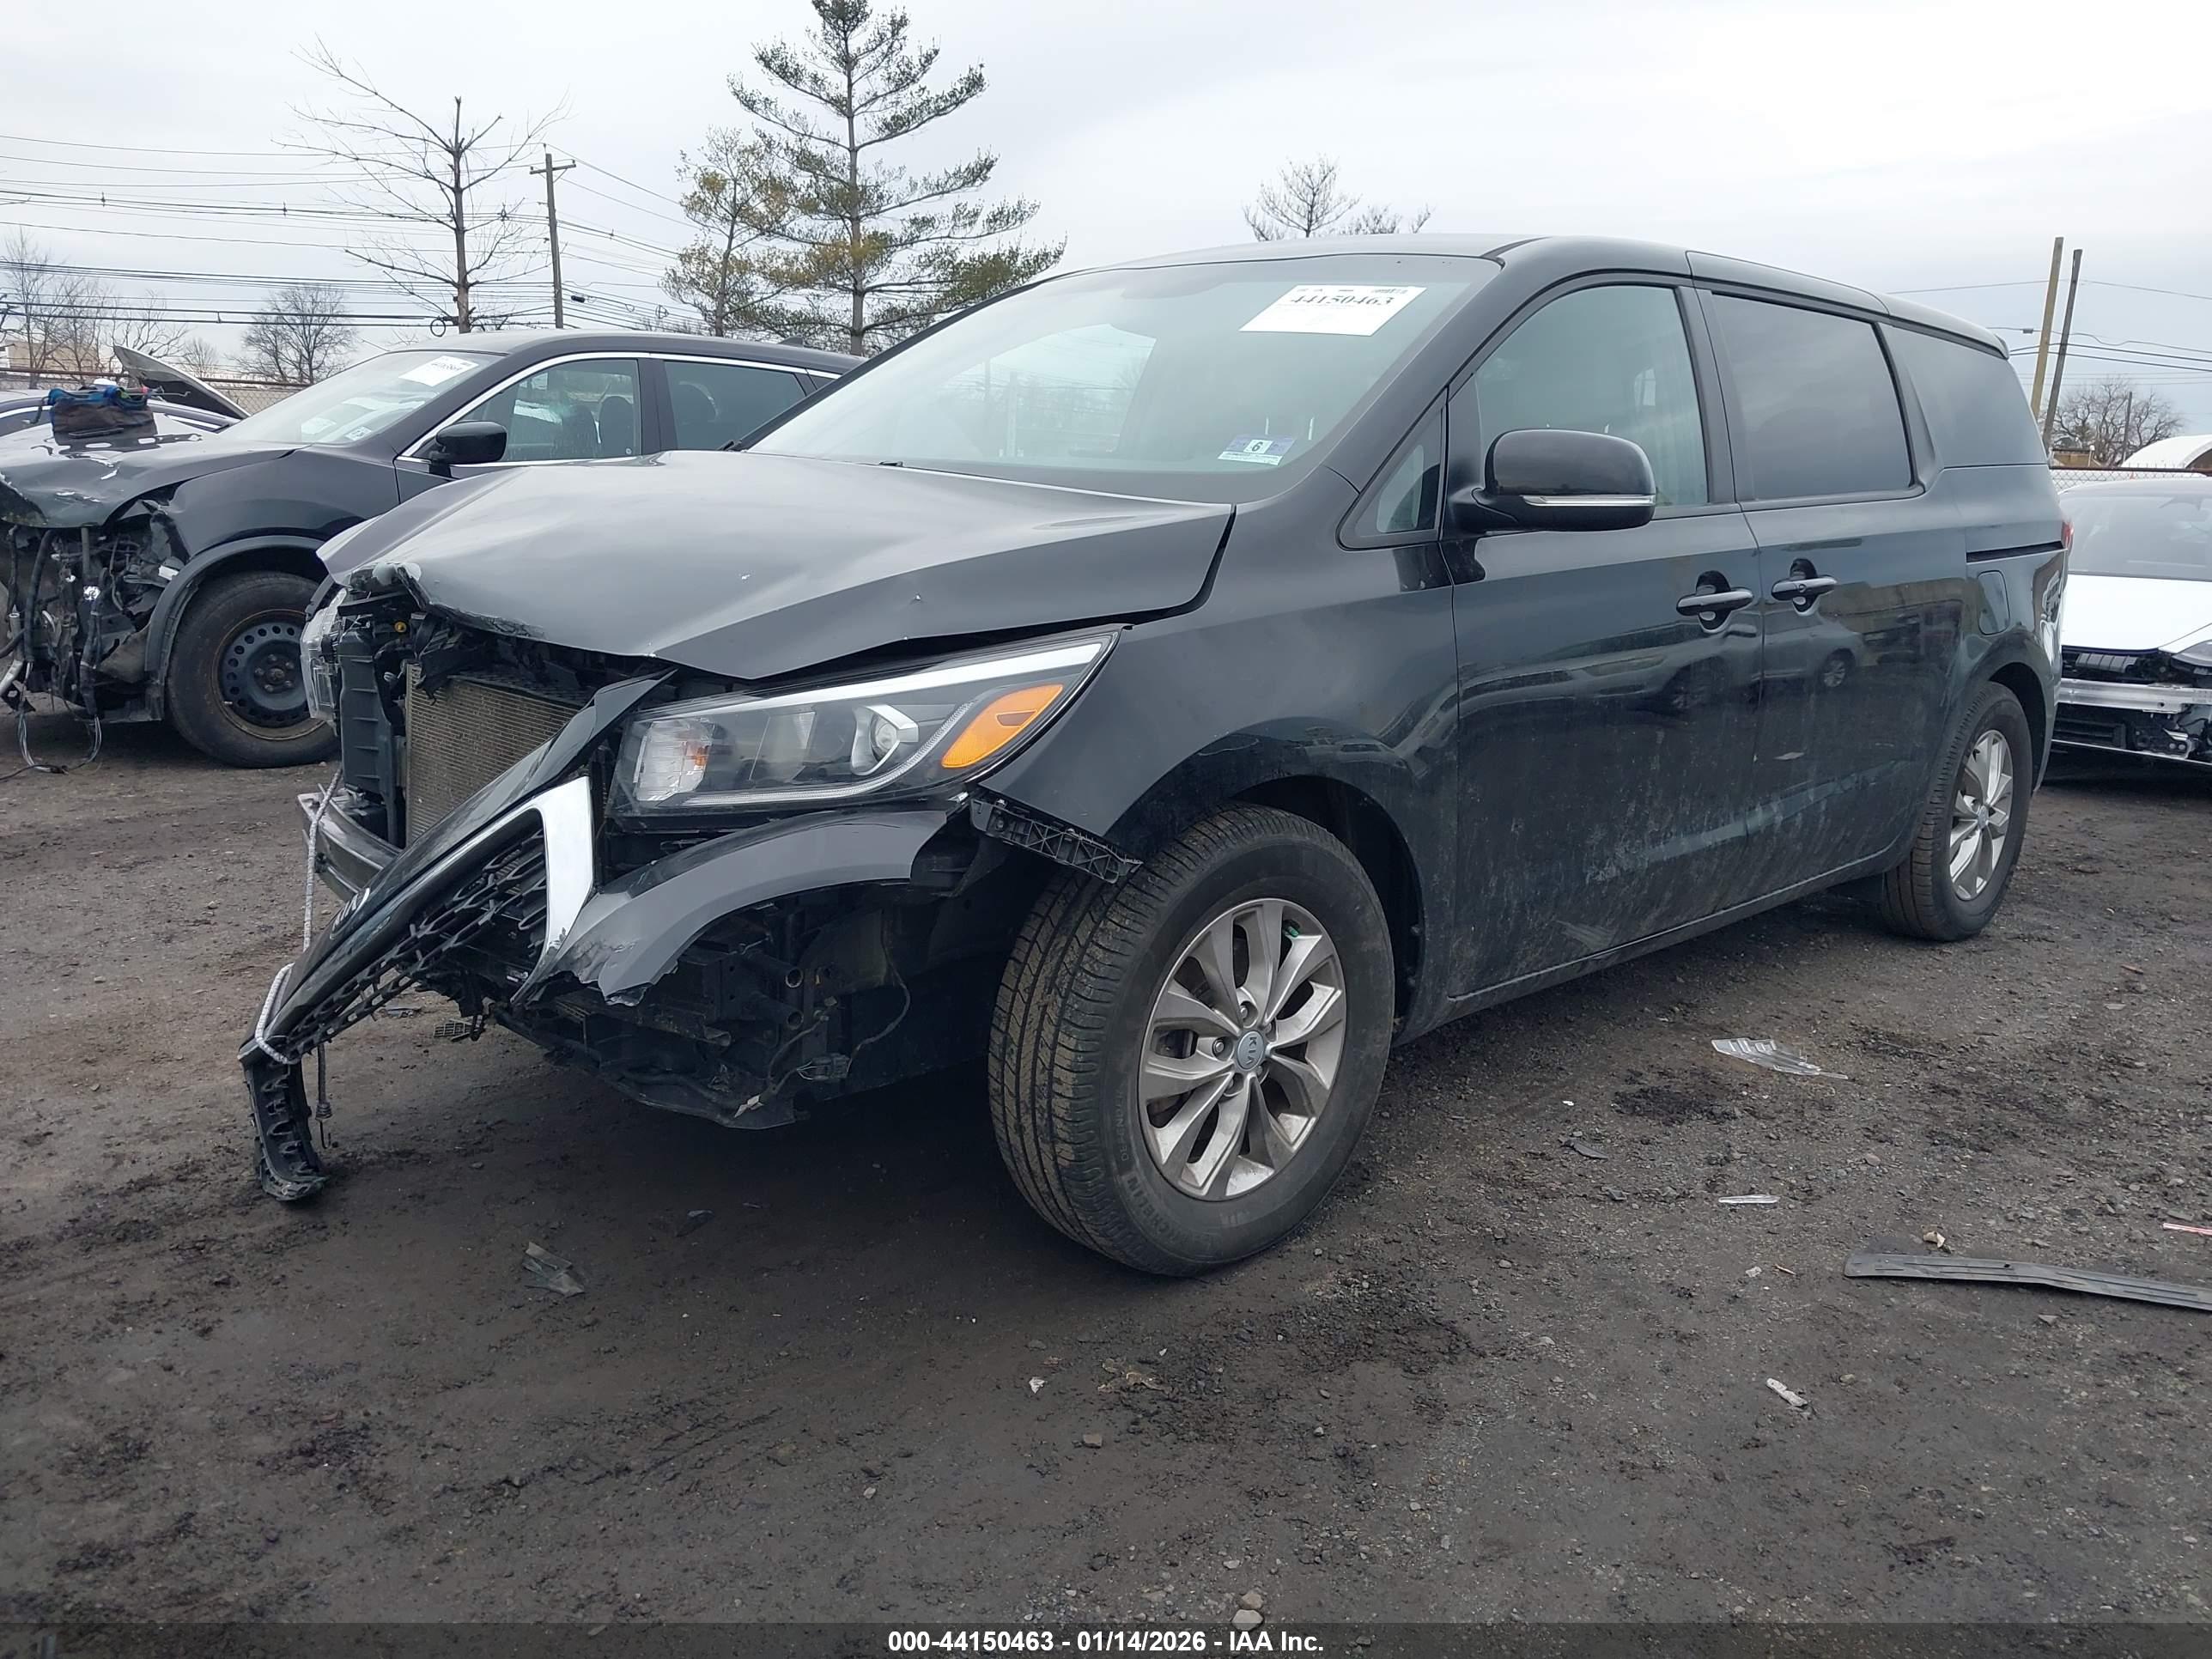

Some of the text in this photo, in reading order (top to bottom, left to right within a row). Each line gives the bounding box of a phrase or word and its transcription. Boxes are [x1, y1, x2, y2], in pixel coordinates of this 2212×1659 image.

[1290, 295, 1395, 306] 44150463
[1251, 441, 1263, 453] 6
[1245, 1036, 1258, 1066] KIA
